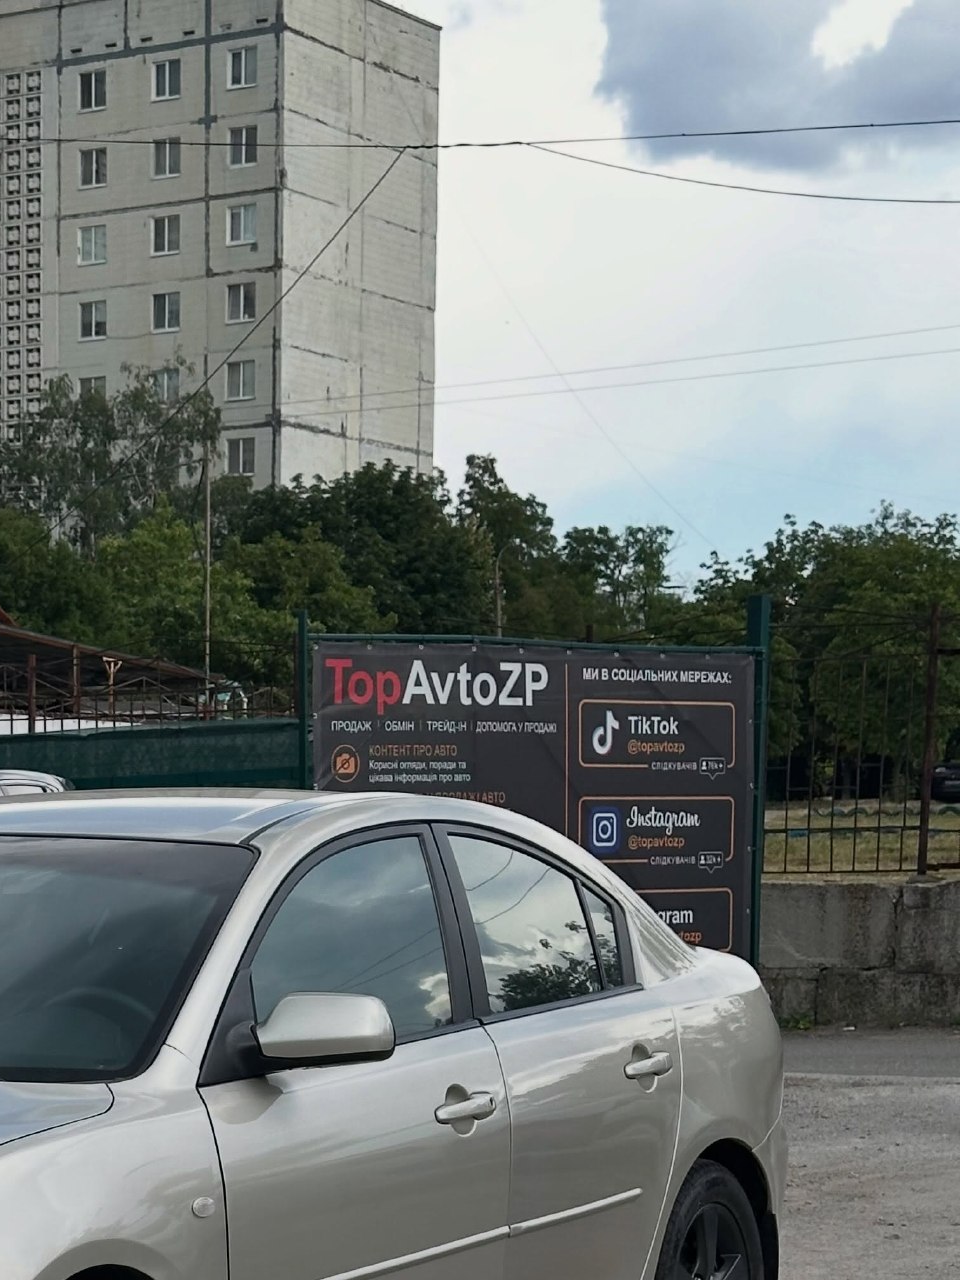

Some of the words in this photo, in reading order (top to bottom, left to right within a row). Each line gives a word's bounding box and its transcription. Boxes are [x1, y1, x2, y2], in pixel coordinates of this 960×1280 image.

[582, 668, 599, 680] МИ
[601, 668, 609, 681] В
[611, 669, 679, 683] СОЦІАЛЬНИХ
[331, 720, 371, 733] ПРОДАЖ
[385, 720, 414, 731] ОБМІН
[426, 719, 467, 734] ТРЕЙД-ІН
[475, 721, 517, 733] ДОПОМОГА
[518, 721, 524, 732] У
[524, 721, 557, 734] ПРОДАЖІ
[628, 716, 679, 735] TikTok
[369, 744, 411, 756] КОНТЕНТ
[413, 745, 433, 756] ПРО
[434, 745, 457, 756] АВТО
[627, 739, 685, 755] @topavtozp
[429, 761, 456, 770] поради
[458, 761, 466, 769] та
[651, 761, 697, 771] СЛІДКУВАЧІВ
[394, 773, 437, 784] інформація
[438, 774, 452, 783] про
[453, 774, 471, 782] авто
[482, 792, 506, 803] АВТО
[626, 806, 700, 836] Instagram
[627, 835, 685, 850] @topavtozp
[650, 856, 695, 866] СЛІДКУВАЧІВ
